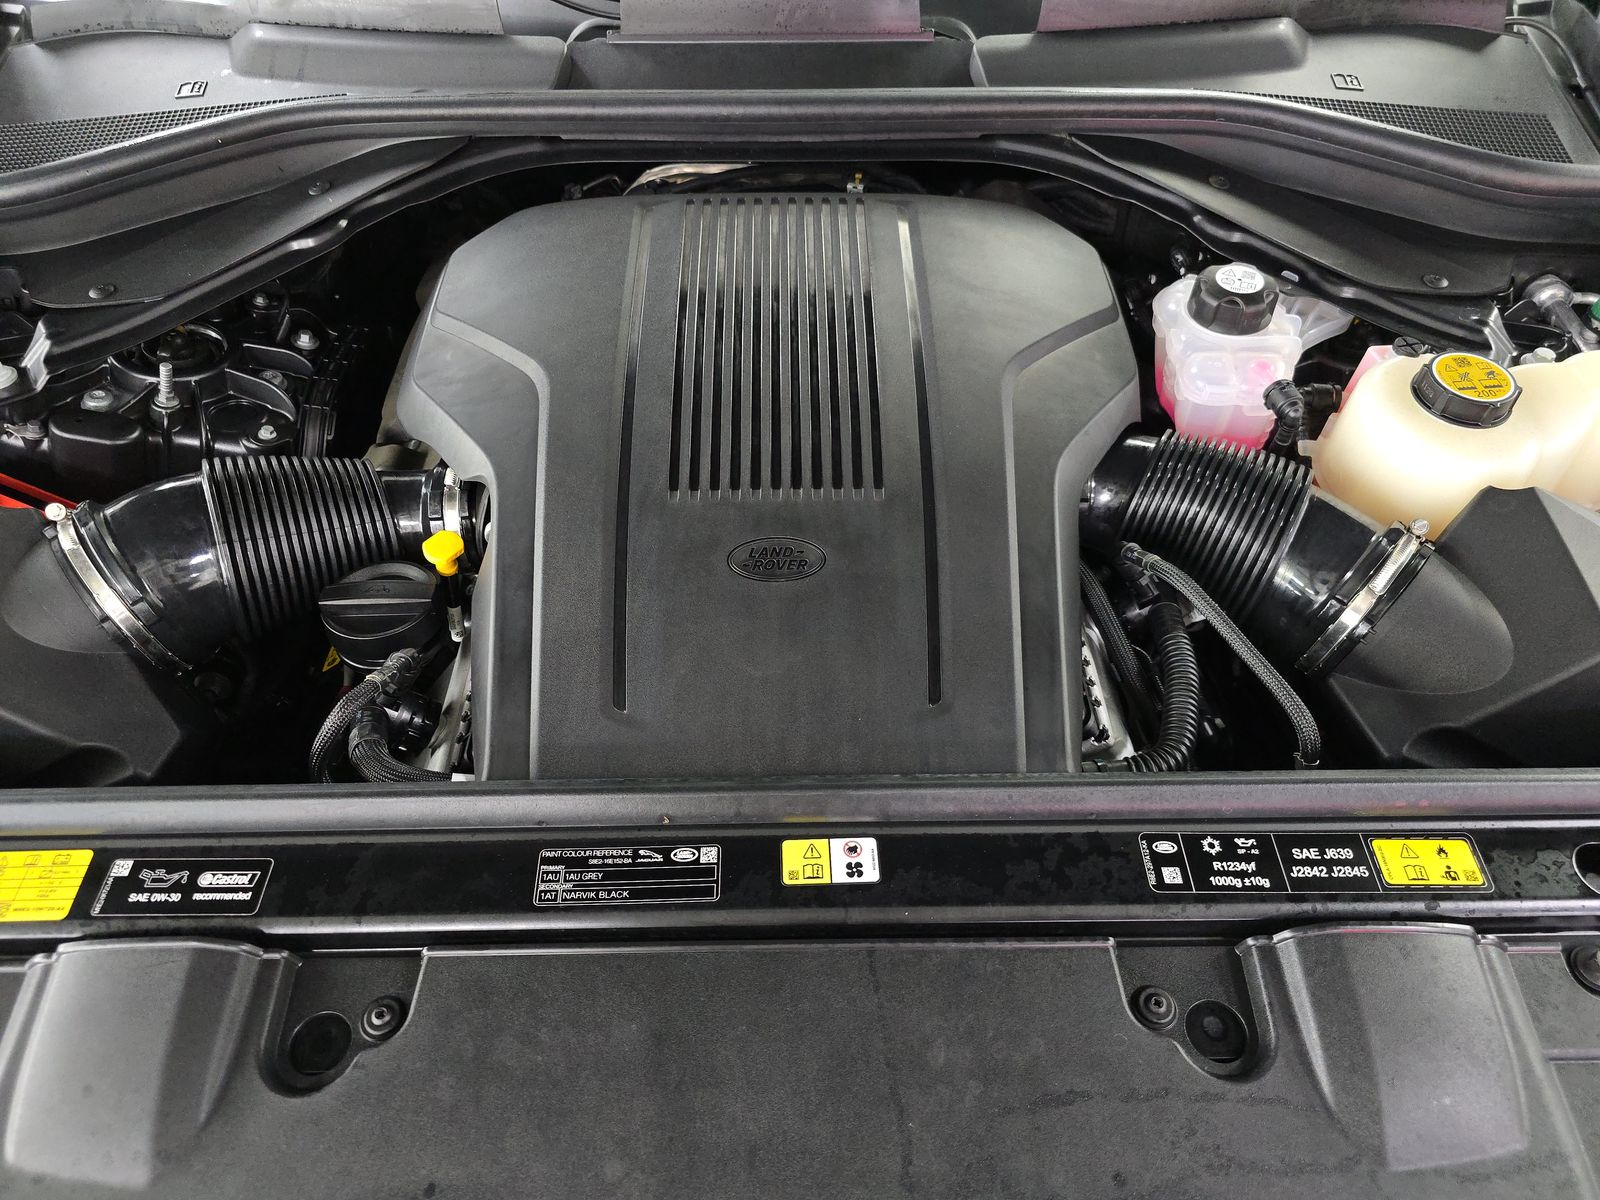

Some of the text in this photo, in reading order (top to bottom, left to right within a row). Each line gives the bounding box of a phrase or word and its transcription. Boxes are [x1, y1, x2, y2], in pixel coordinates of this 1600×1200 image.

[1474, 389, 1497, 398] 200
[748, 546, 795, 558] LAND
[751, 558, 810, 571] ROVER
[542, 850, 561, 858] PAINT
[593, 849, 633, 857] REFERENCE
[1292, 848, 1354, 859] SAE J639
[1212, 861, 1256, 873] R1234yf
[1290, 865, 1369, 877] J2842 J2845
[211, 873, 252, 885] Castrol
[542, 873, 560, 881] 1AU
[581, 872, 604, 880] GREY
[1209, 876, 1271, 888] 1000g ±10g
[128, 892, 182, 902] SAE 0W-30
[192, 891, 252, 901] recommended
[540, 892, 557, 900] 1AT
[562, 890, 630, 899] NARVIK BLACK
